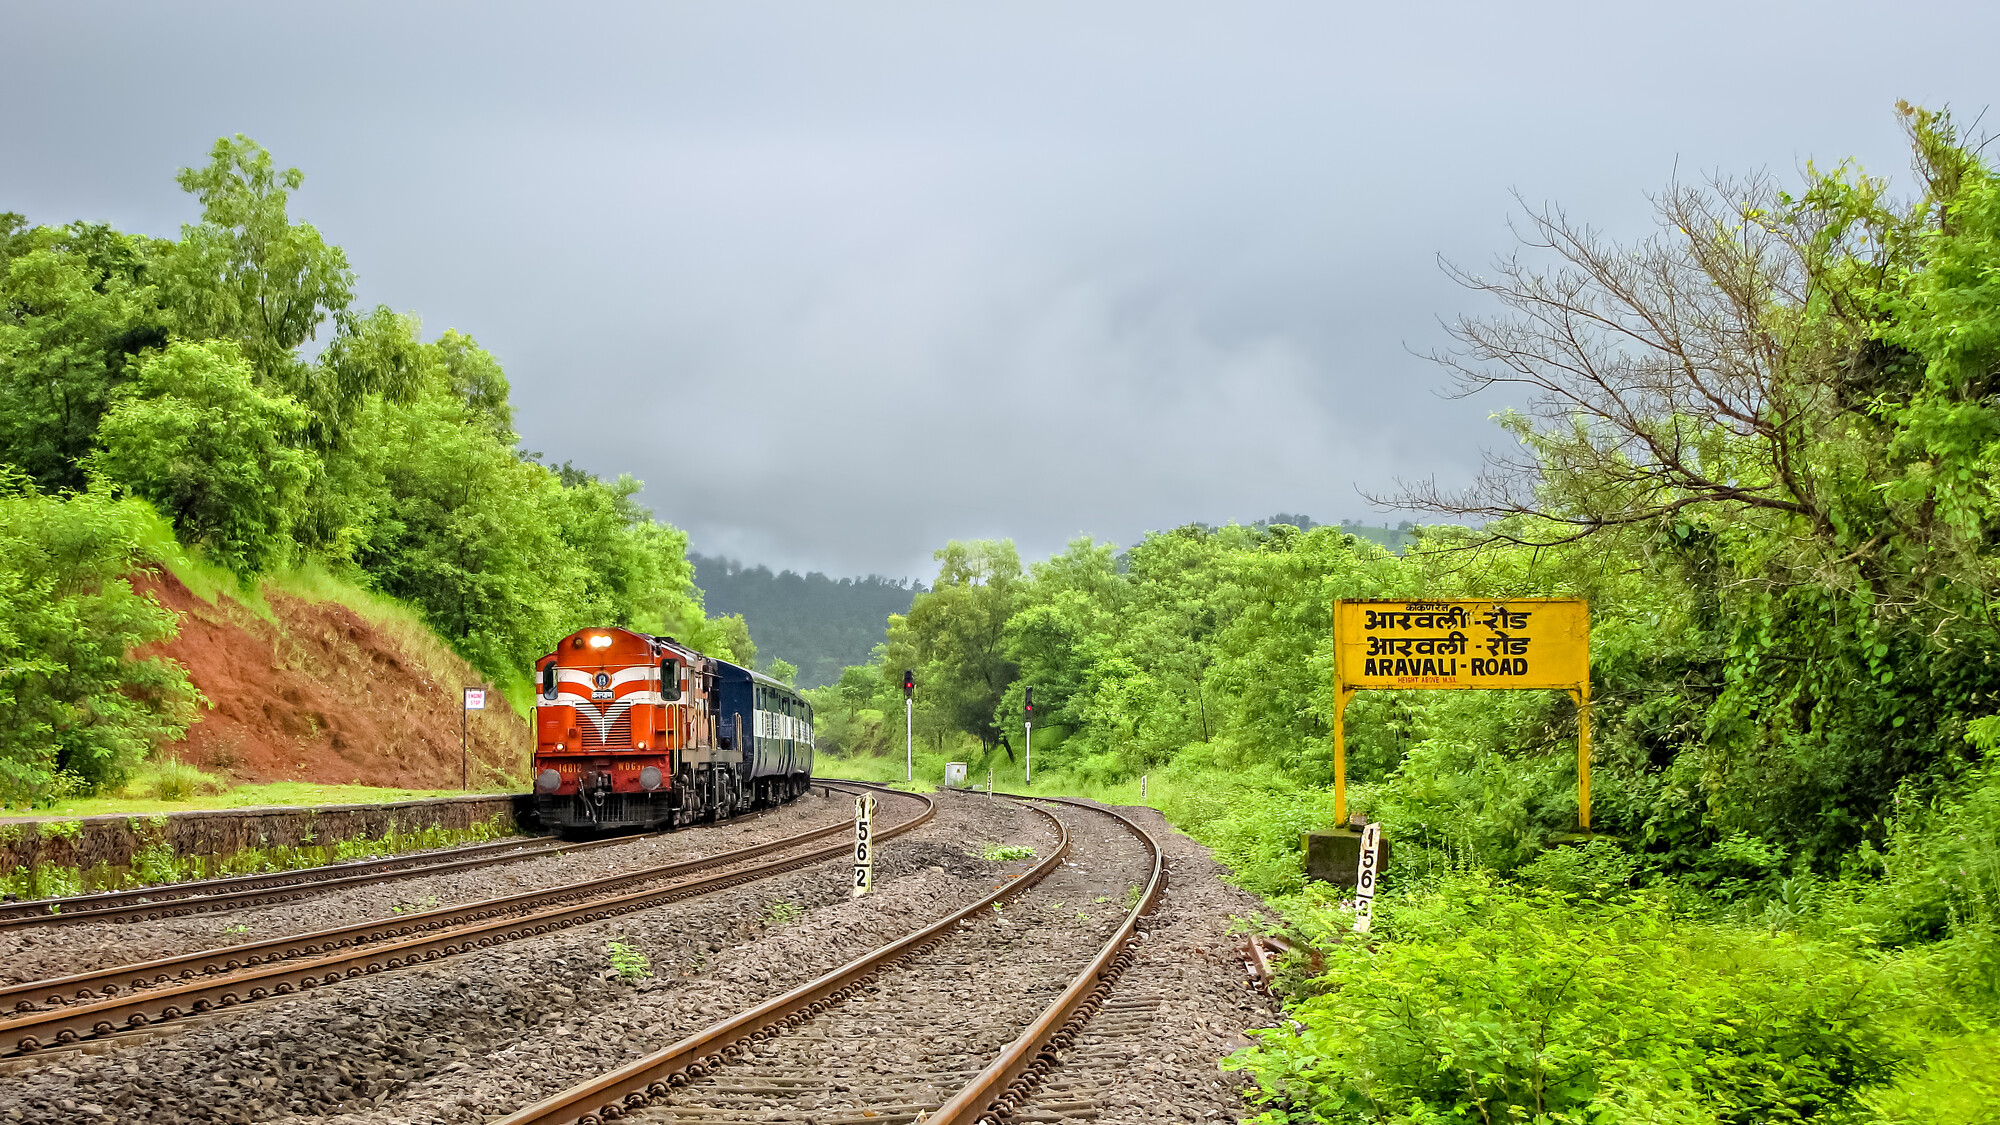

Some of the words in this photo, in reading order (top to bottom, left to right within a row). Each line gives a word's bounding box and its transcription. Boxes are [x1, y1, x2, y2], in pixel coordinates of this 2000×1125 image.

[1366, 631, 1469, 657] आरवली
[1486, 631, 1531, 657] रोड
[1364, 658, 1457, 676] ARAVALI
[1471, 657, 1528, 676] ROAD
